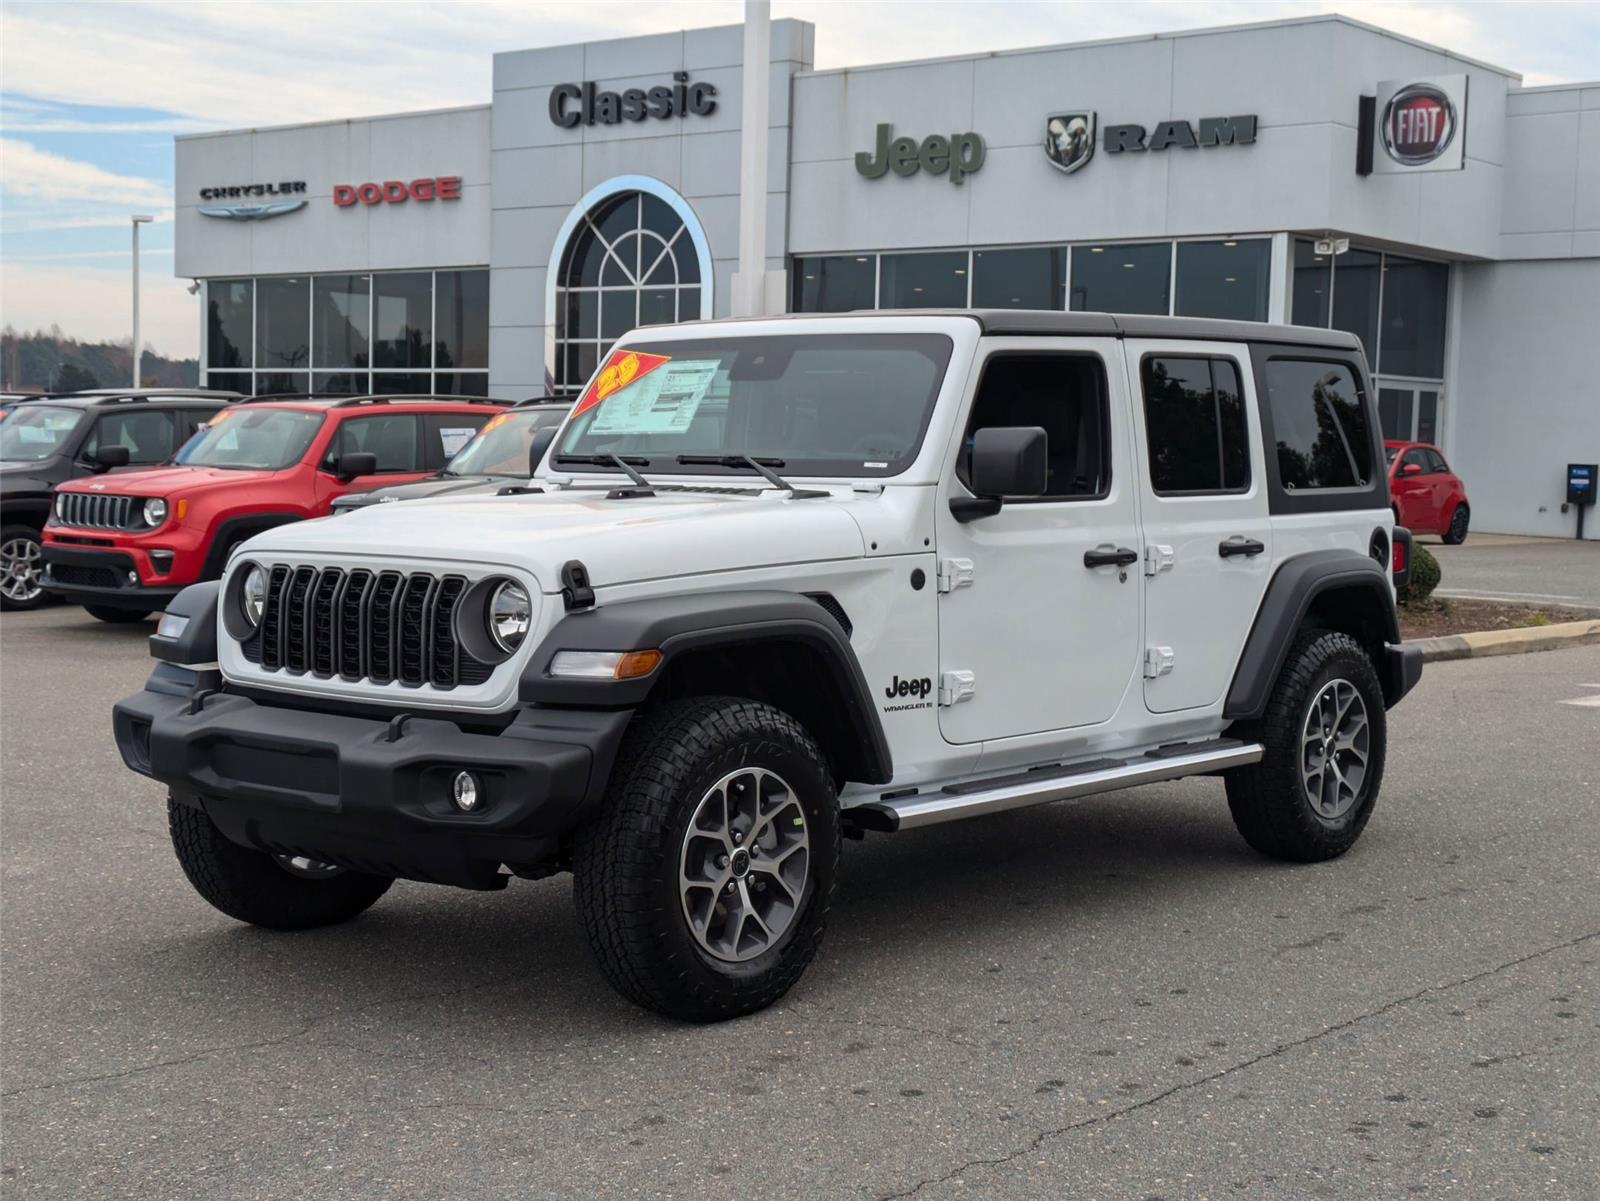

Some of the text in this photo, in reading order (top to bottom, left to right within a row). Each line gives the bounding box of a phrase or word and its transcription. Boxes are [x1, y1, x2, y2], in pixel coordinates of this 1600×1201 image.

[548, 72, 718, 129] Classic
[1103, 114, 1258, 155] RAM
[1397, 106, 1441, 145] FIAT
[855, 123, 987, 186] Jeep
[200, 181, 306, 200] CHRYSLER
[333, 176, 463, 208] DODGE
[885, 675, 931, 699] Jeep
[884, 703, 926, 713] WRANGLER
